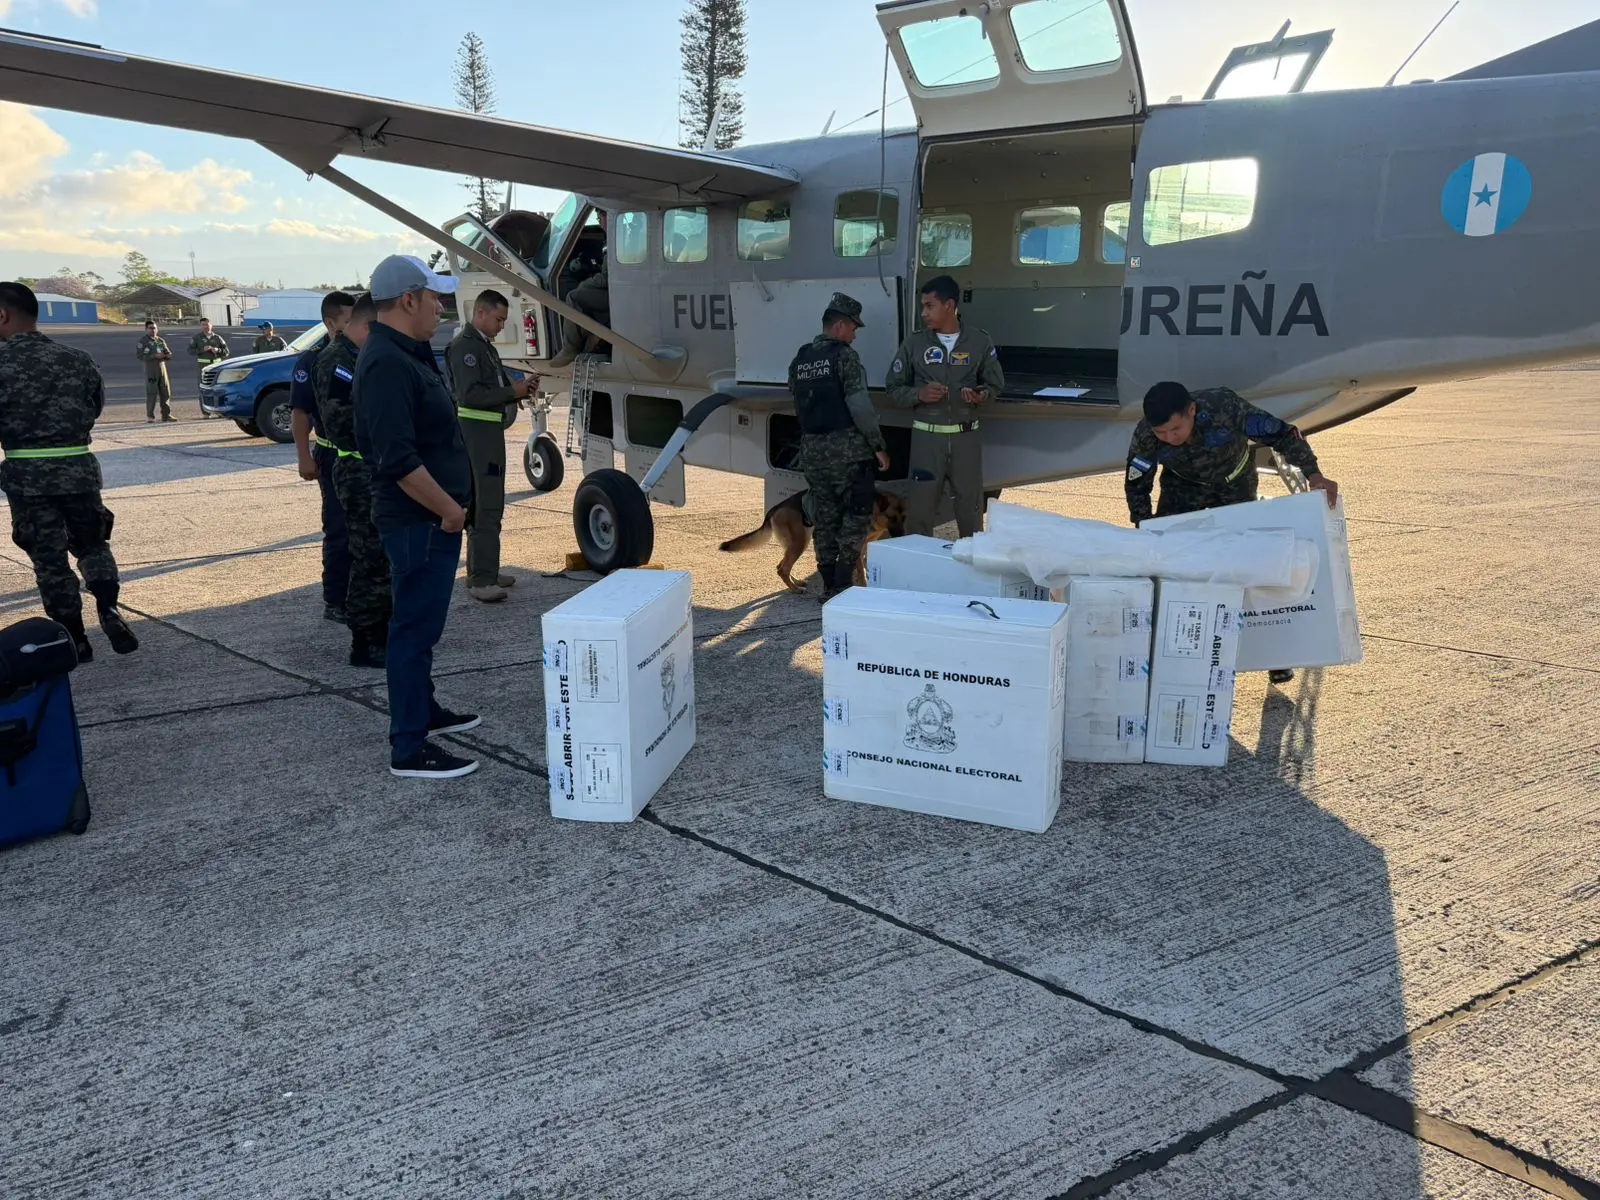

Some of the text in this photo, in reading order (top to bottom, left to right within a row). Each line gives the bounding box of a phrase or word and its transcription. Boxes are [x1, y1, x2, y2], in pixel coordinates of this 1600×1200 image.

[673, 294, 734, 331] FUE
[797, 359, 830, 371] POLICIA
[797, 367, 830, 380] MILITAR
[1247, 618, 1292, 628] Democracia
[1262, 604, 1316, 616] ELECTORAL
[1211, 635, 1222, 667] ABRIR
[857, 661, 1011, 688] REPÚBLICA DE HONDURAS
[561, 674, 570, 704] ESTE
[563, 732, 573, 768] ABRIR
[896, 757, 952, 773] NACIONAL
[955, 766, 1022, 783] ELECTORAL
